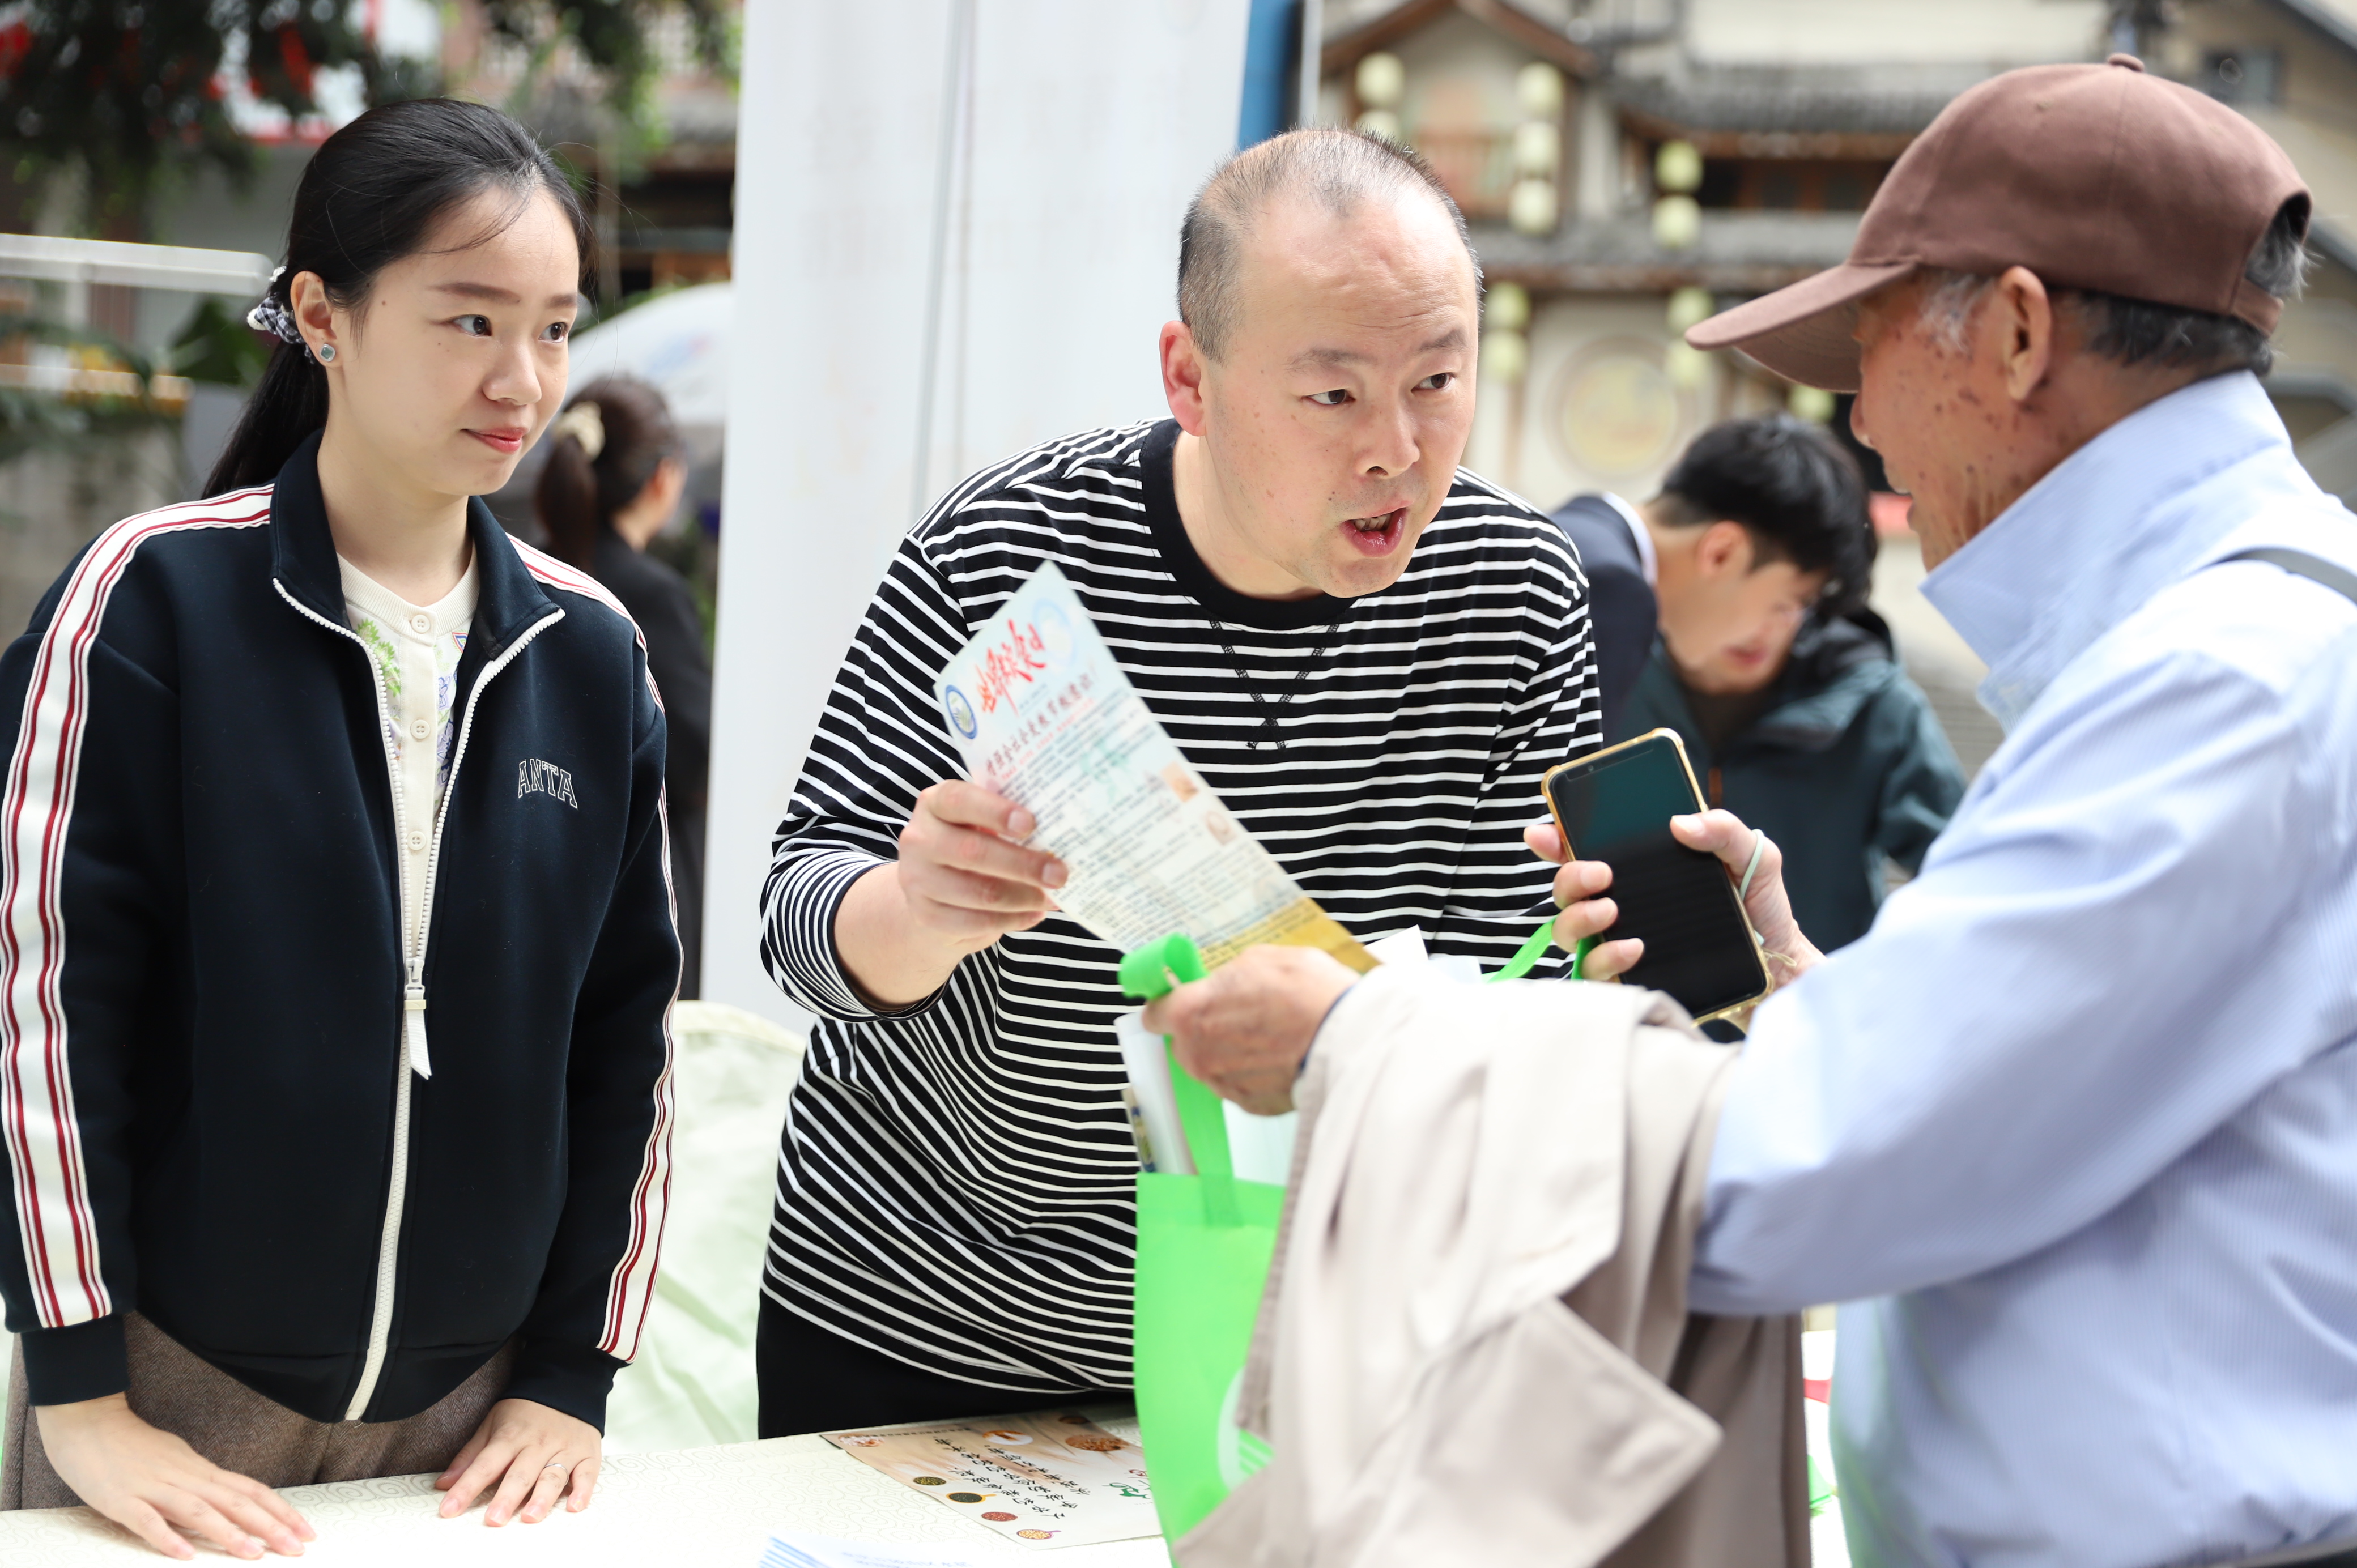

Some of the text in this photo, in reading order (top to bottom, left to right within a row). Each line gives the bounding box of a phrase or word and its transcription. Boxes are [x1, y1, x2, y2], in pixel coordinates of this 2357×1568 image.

[975, 619, 1046, 717] 世界粮食日
[518, 758, 578, 809] ANTA
